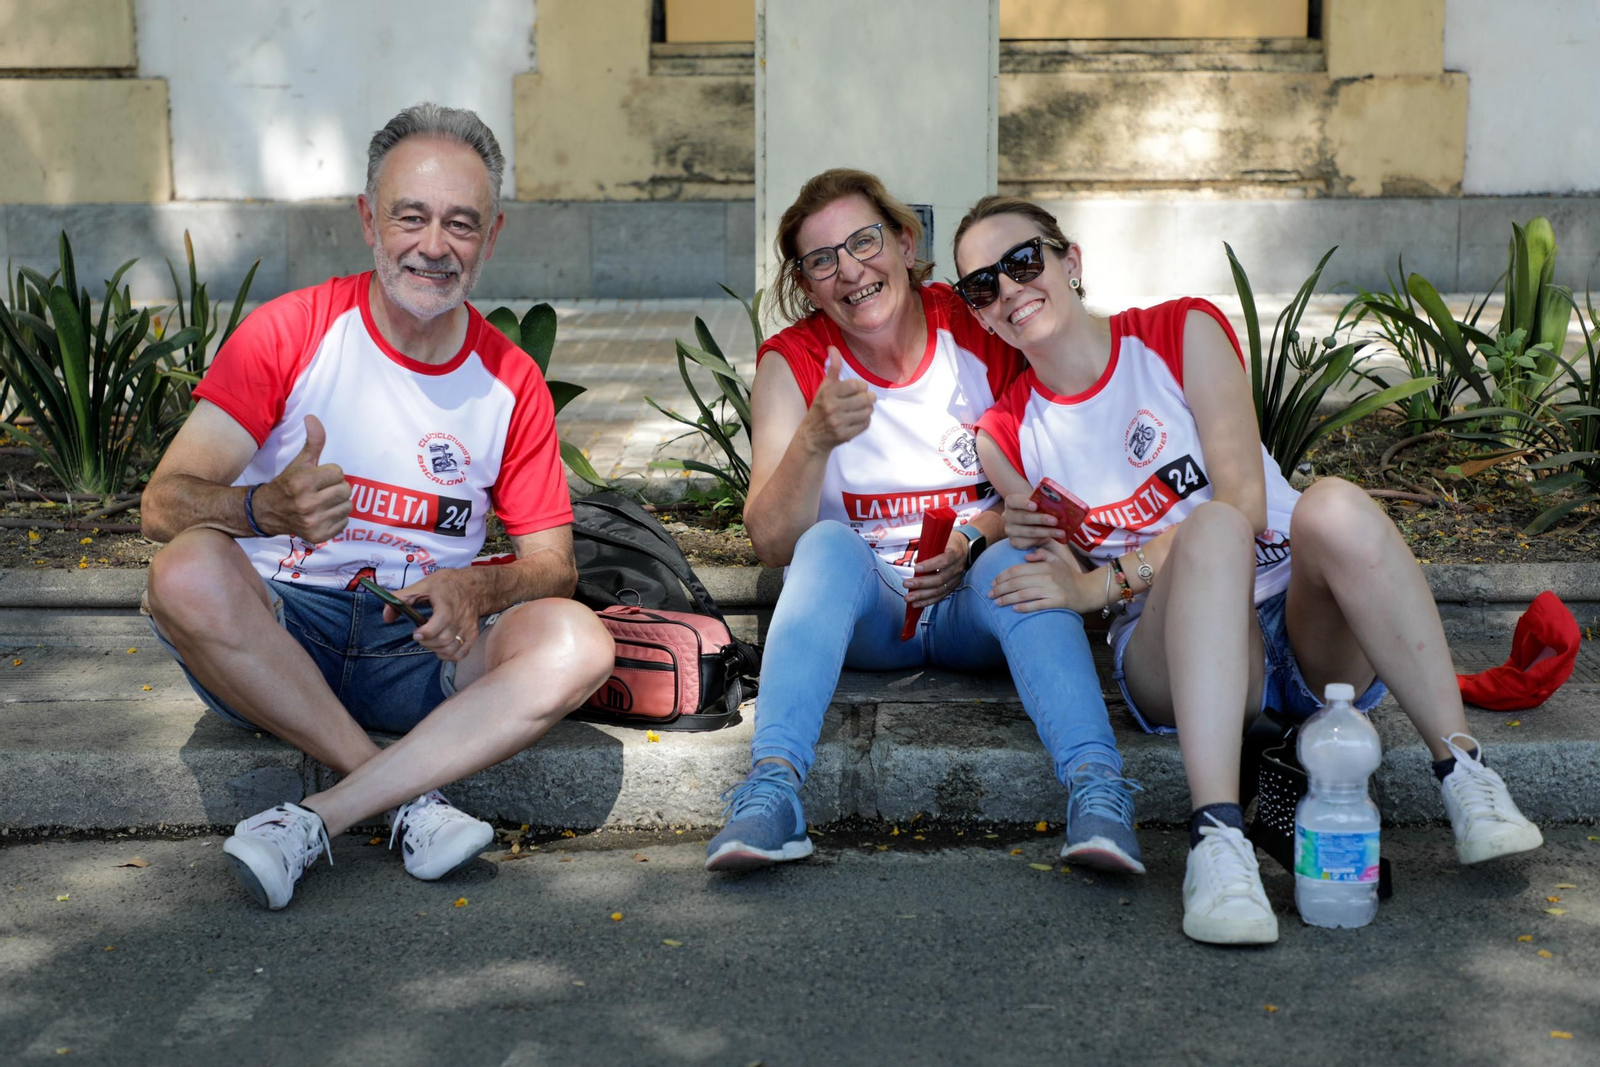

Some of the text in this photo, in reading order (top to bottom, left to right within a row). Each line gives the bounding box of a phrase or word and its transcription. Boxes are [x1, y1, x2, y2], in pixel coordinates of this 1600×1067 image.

[418, 433, 434, 448] CLU
[417, 454, 466, 486] BACALON
[943, 458, 984, 476] BACALO
[1168, 461, 1199, 494] 24
[439, 505, 469, 530] 24
[856, 499, 883, 518] LA
[1073, 522, 1102, 546] LA
[1090, 484, 1169, 528] VUELTA
